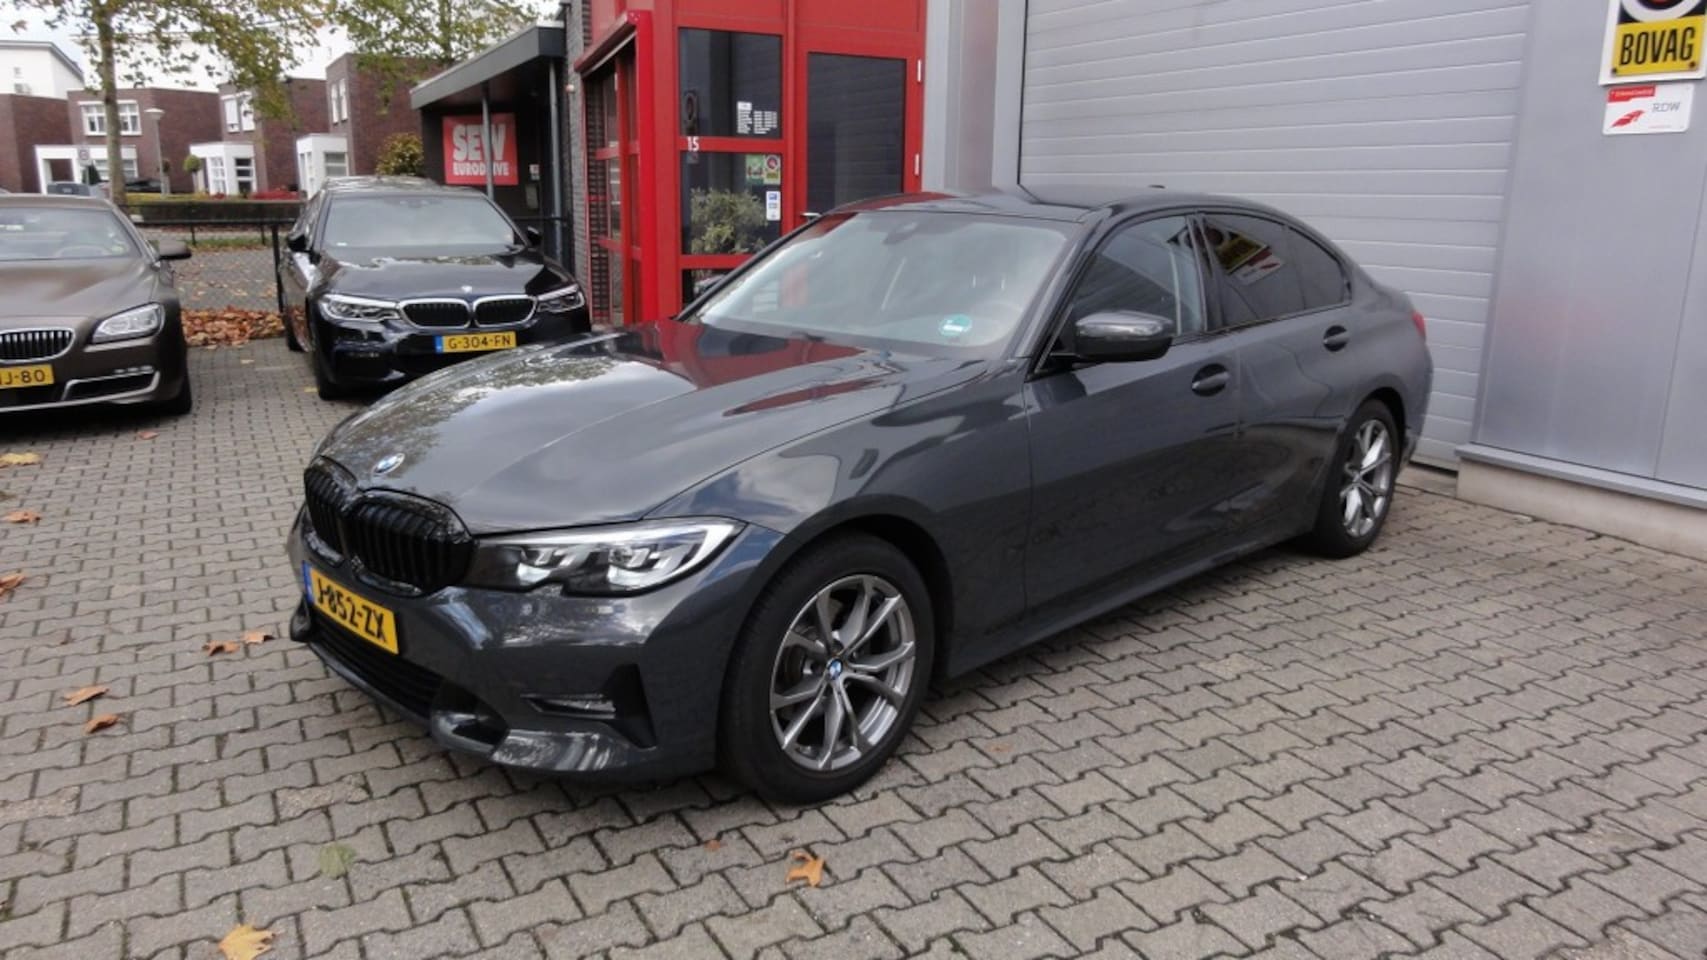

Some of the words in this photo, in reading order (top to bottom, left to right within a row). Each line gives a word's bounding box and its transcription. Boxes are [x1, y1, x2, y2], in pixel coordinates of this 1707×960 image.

[1619, 27, 1696, 66] BOVAG
[1652, 102, 1681, 113] RDW
[453, 124, 506, 161] SEW
[687, 136, 699, 151] 15
[453, 162, 509, 176] EURODIVE
[448, 335, 511, 350] G-304-FN
[0, 369, 46, 385] J-80
[318, 578, 387, 643] J-852-ZX
